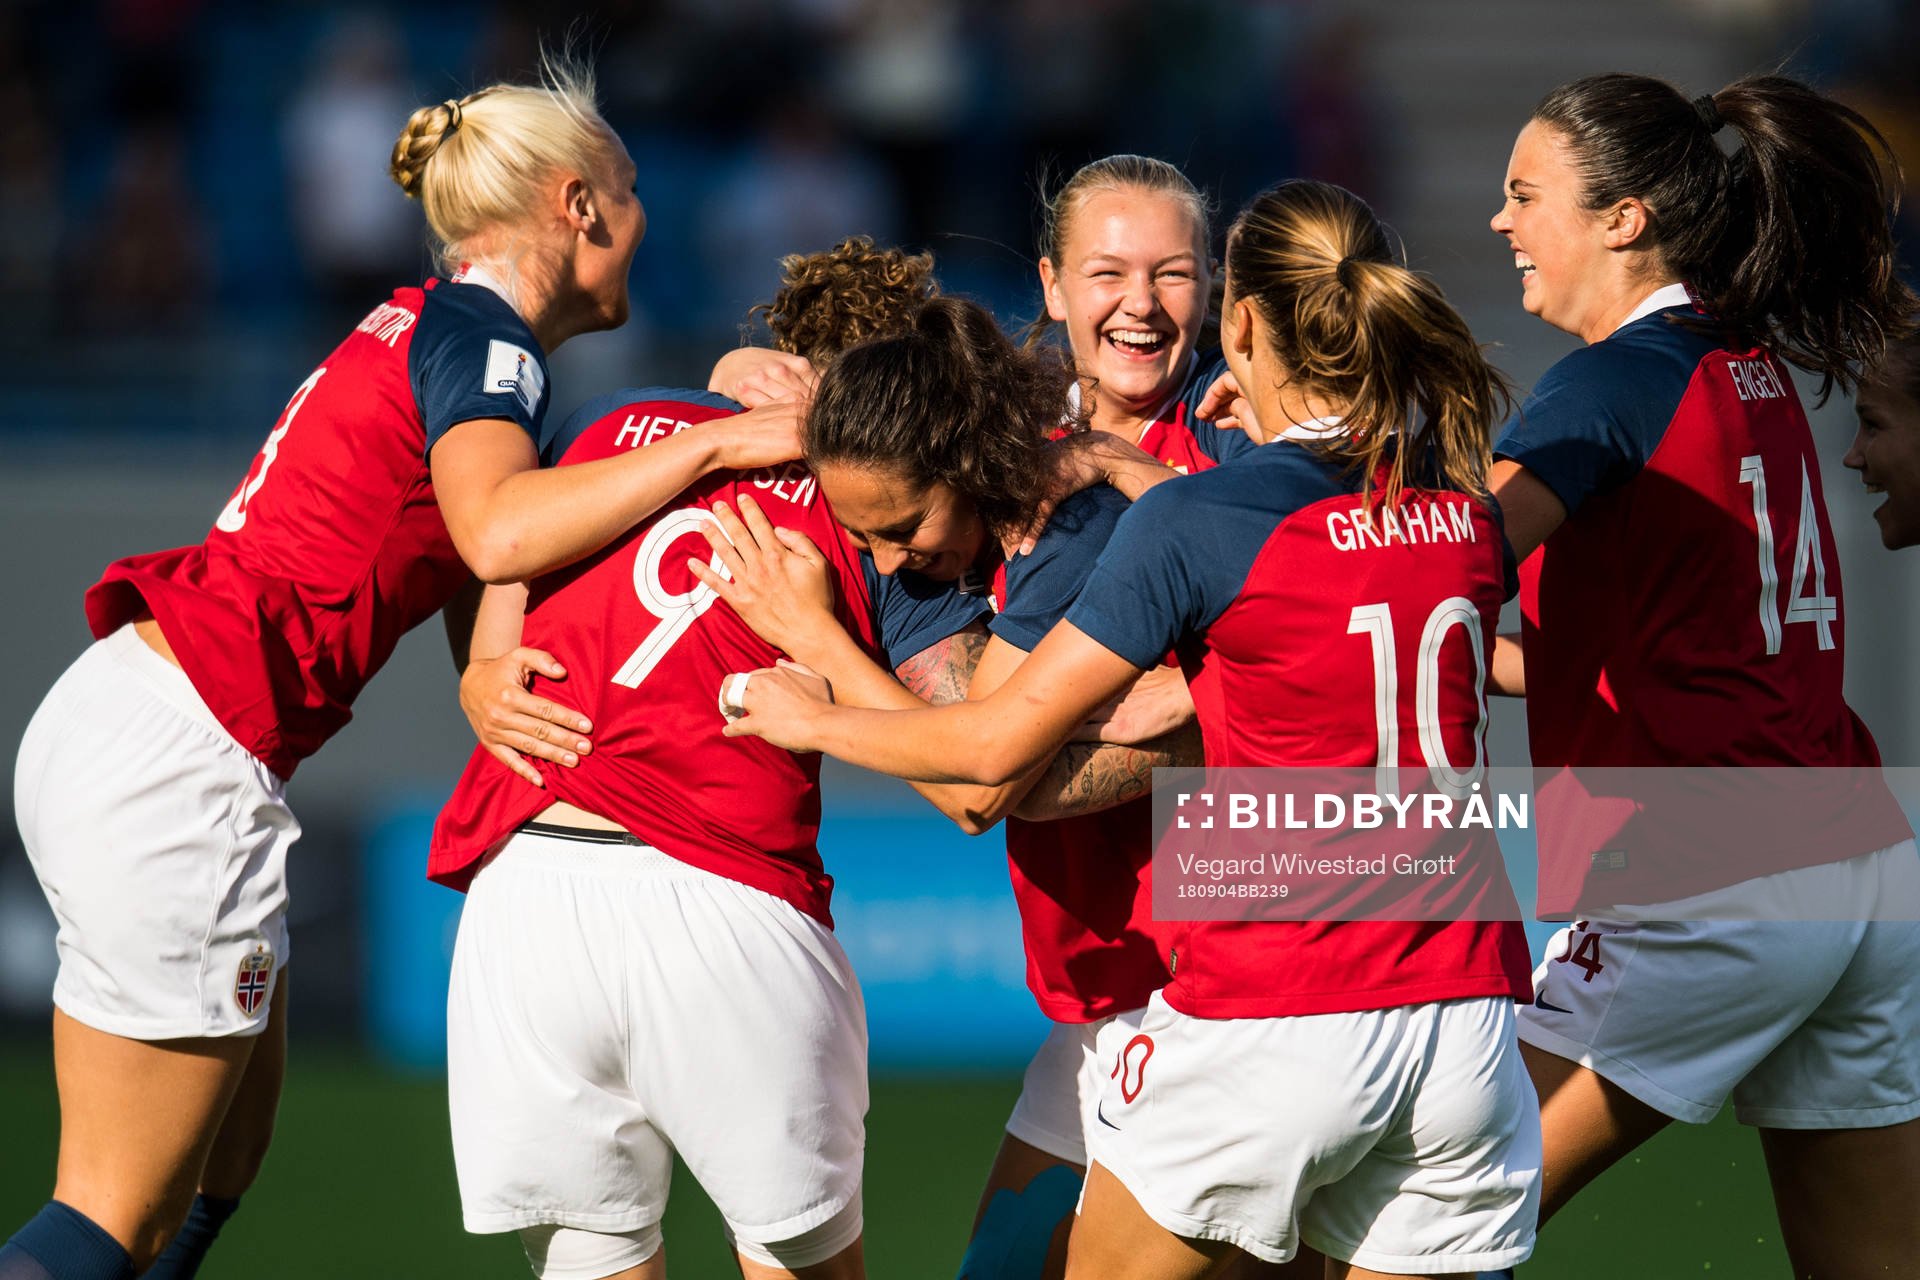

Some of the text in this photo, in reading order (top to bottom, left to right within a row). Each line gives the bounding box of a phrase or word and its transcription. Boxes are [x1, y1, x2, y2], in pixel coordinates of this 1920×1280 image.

[1727, 359, 1786, 401] ENGEN
[610, 507, 735, 690] 9
[1326, 501, 1476, 552] GRAHAM
[1739, 452, 1837, 655] 14
[1346, 596, 1488, 807] 10
